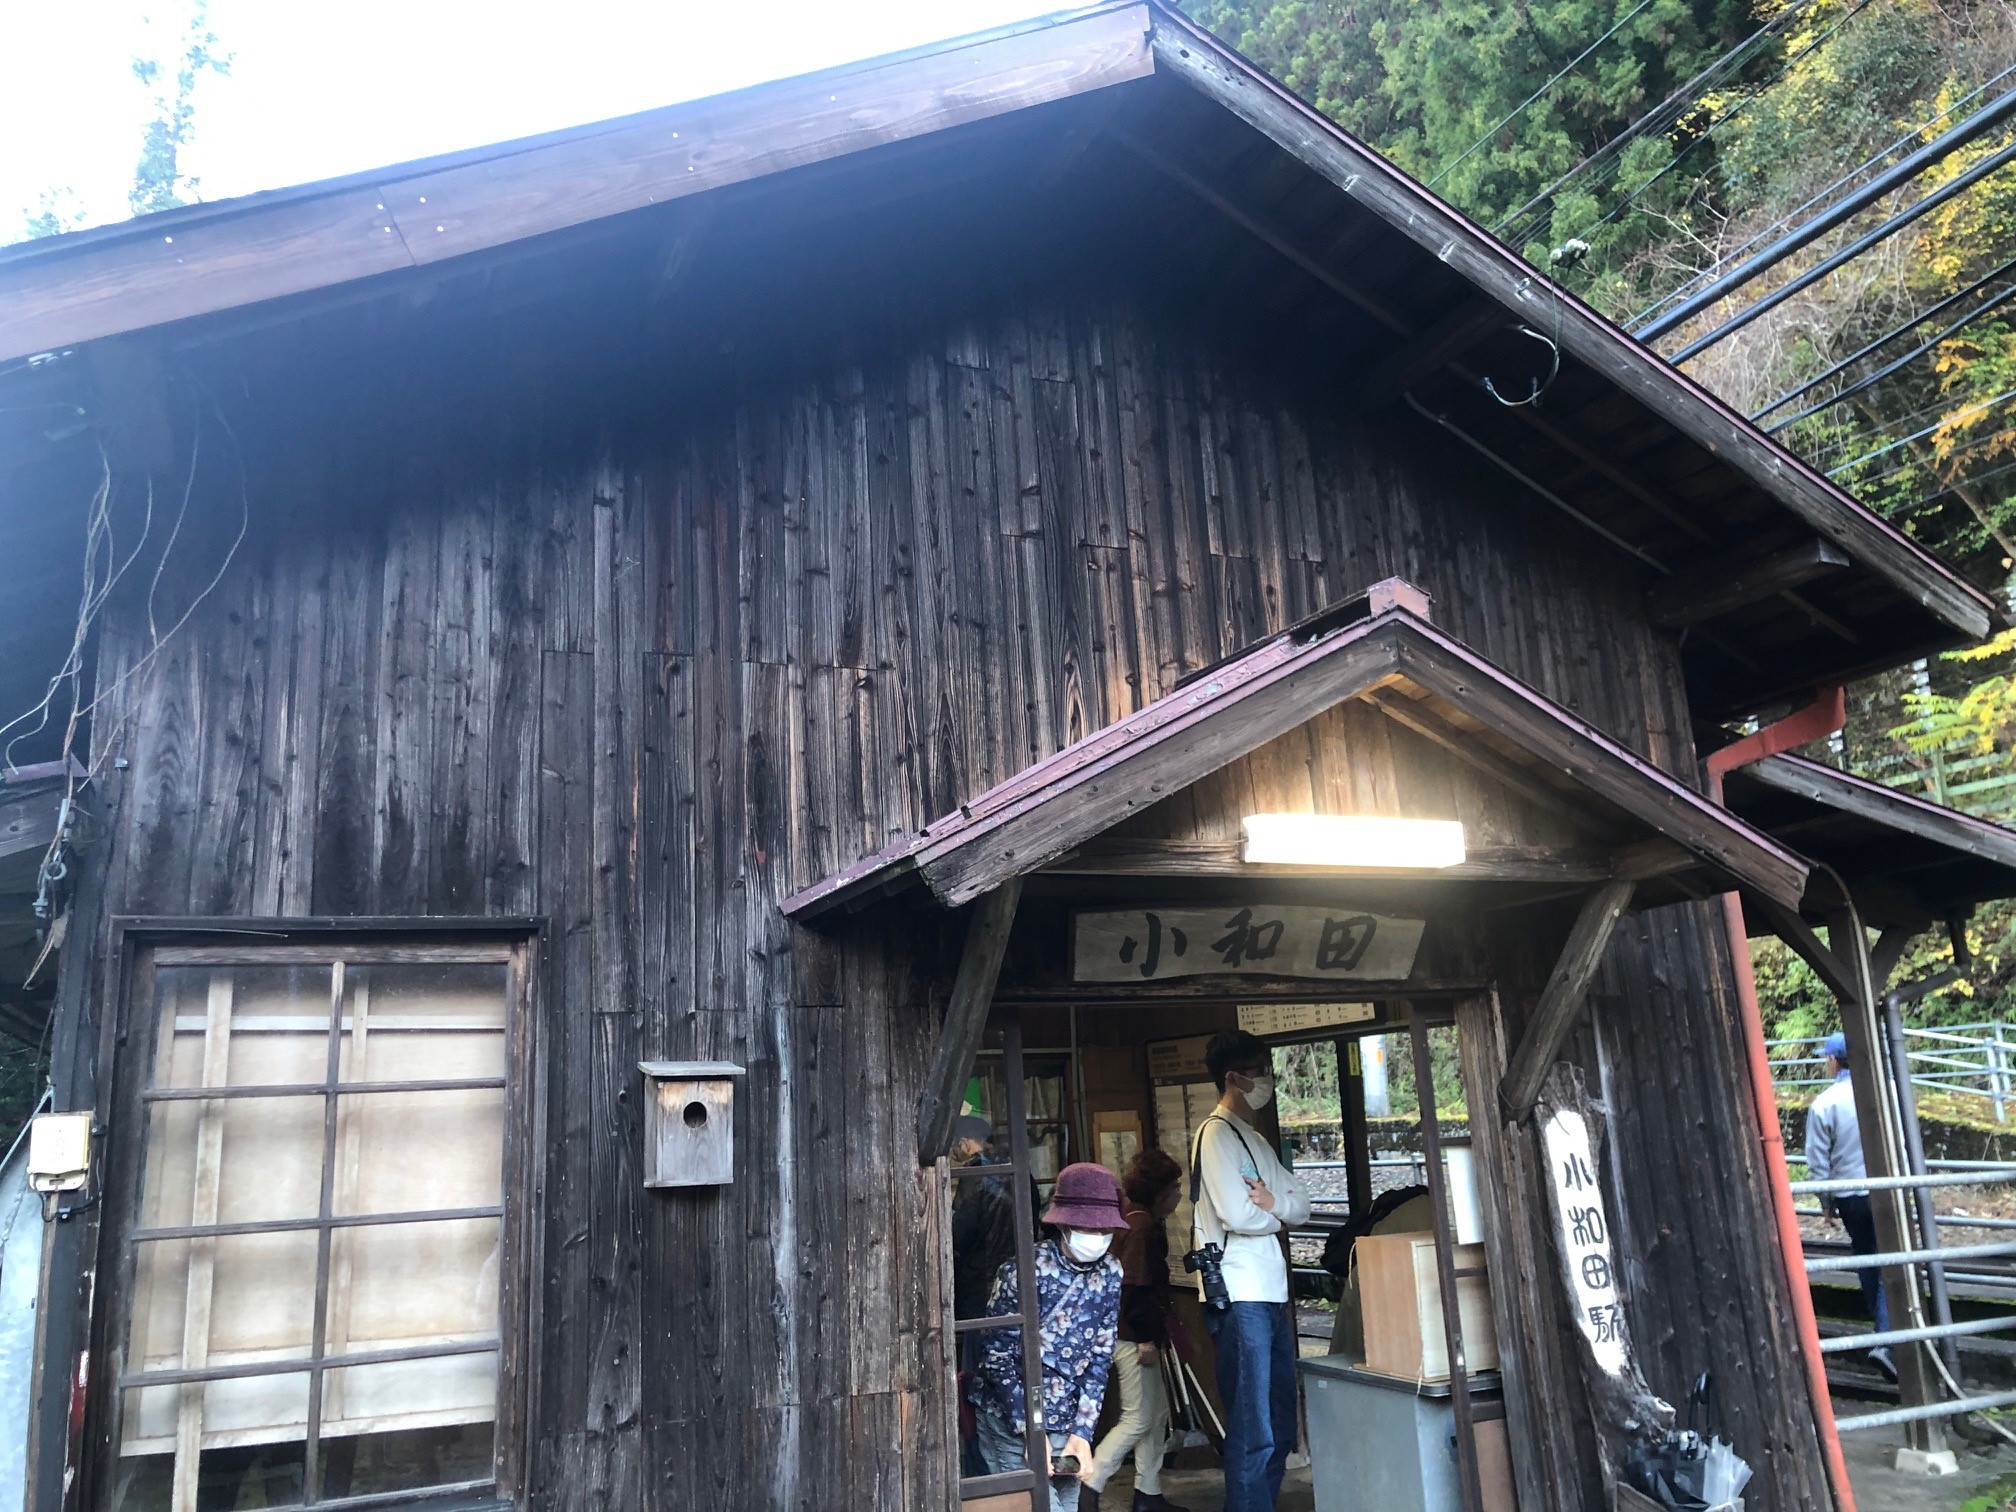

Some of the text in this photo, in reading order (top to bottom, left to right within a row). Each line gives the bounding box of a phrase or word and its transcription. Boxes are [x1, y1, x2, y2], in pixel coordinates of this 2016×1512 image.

[1119, 907, 1377, 977] 小和田
[1564, 1153, 1619, 1343] 小和田駅
